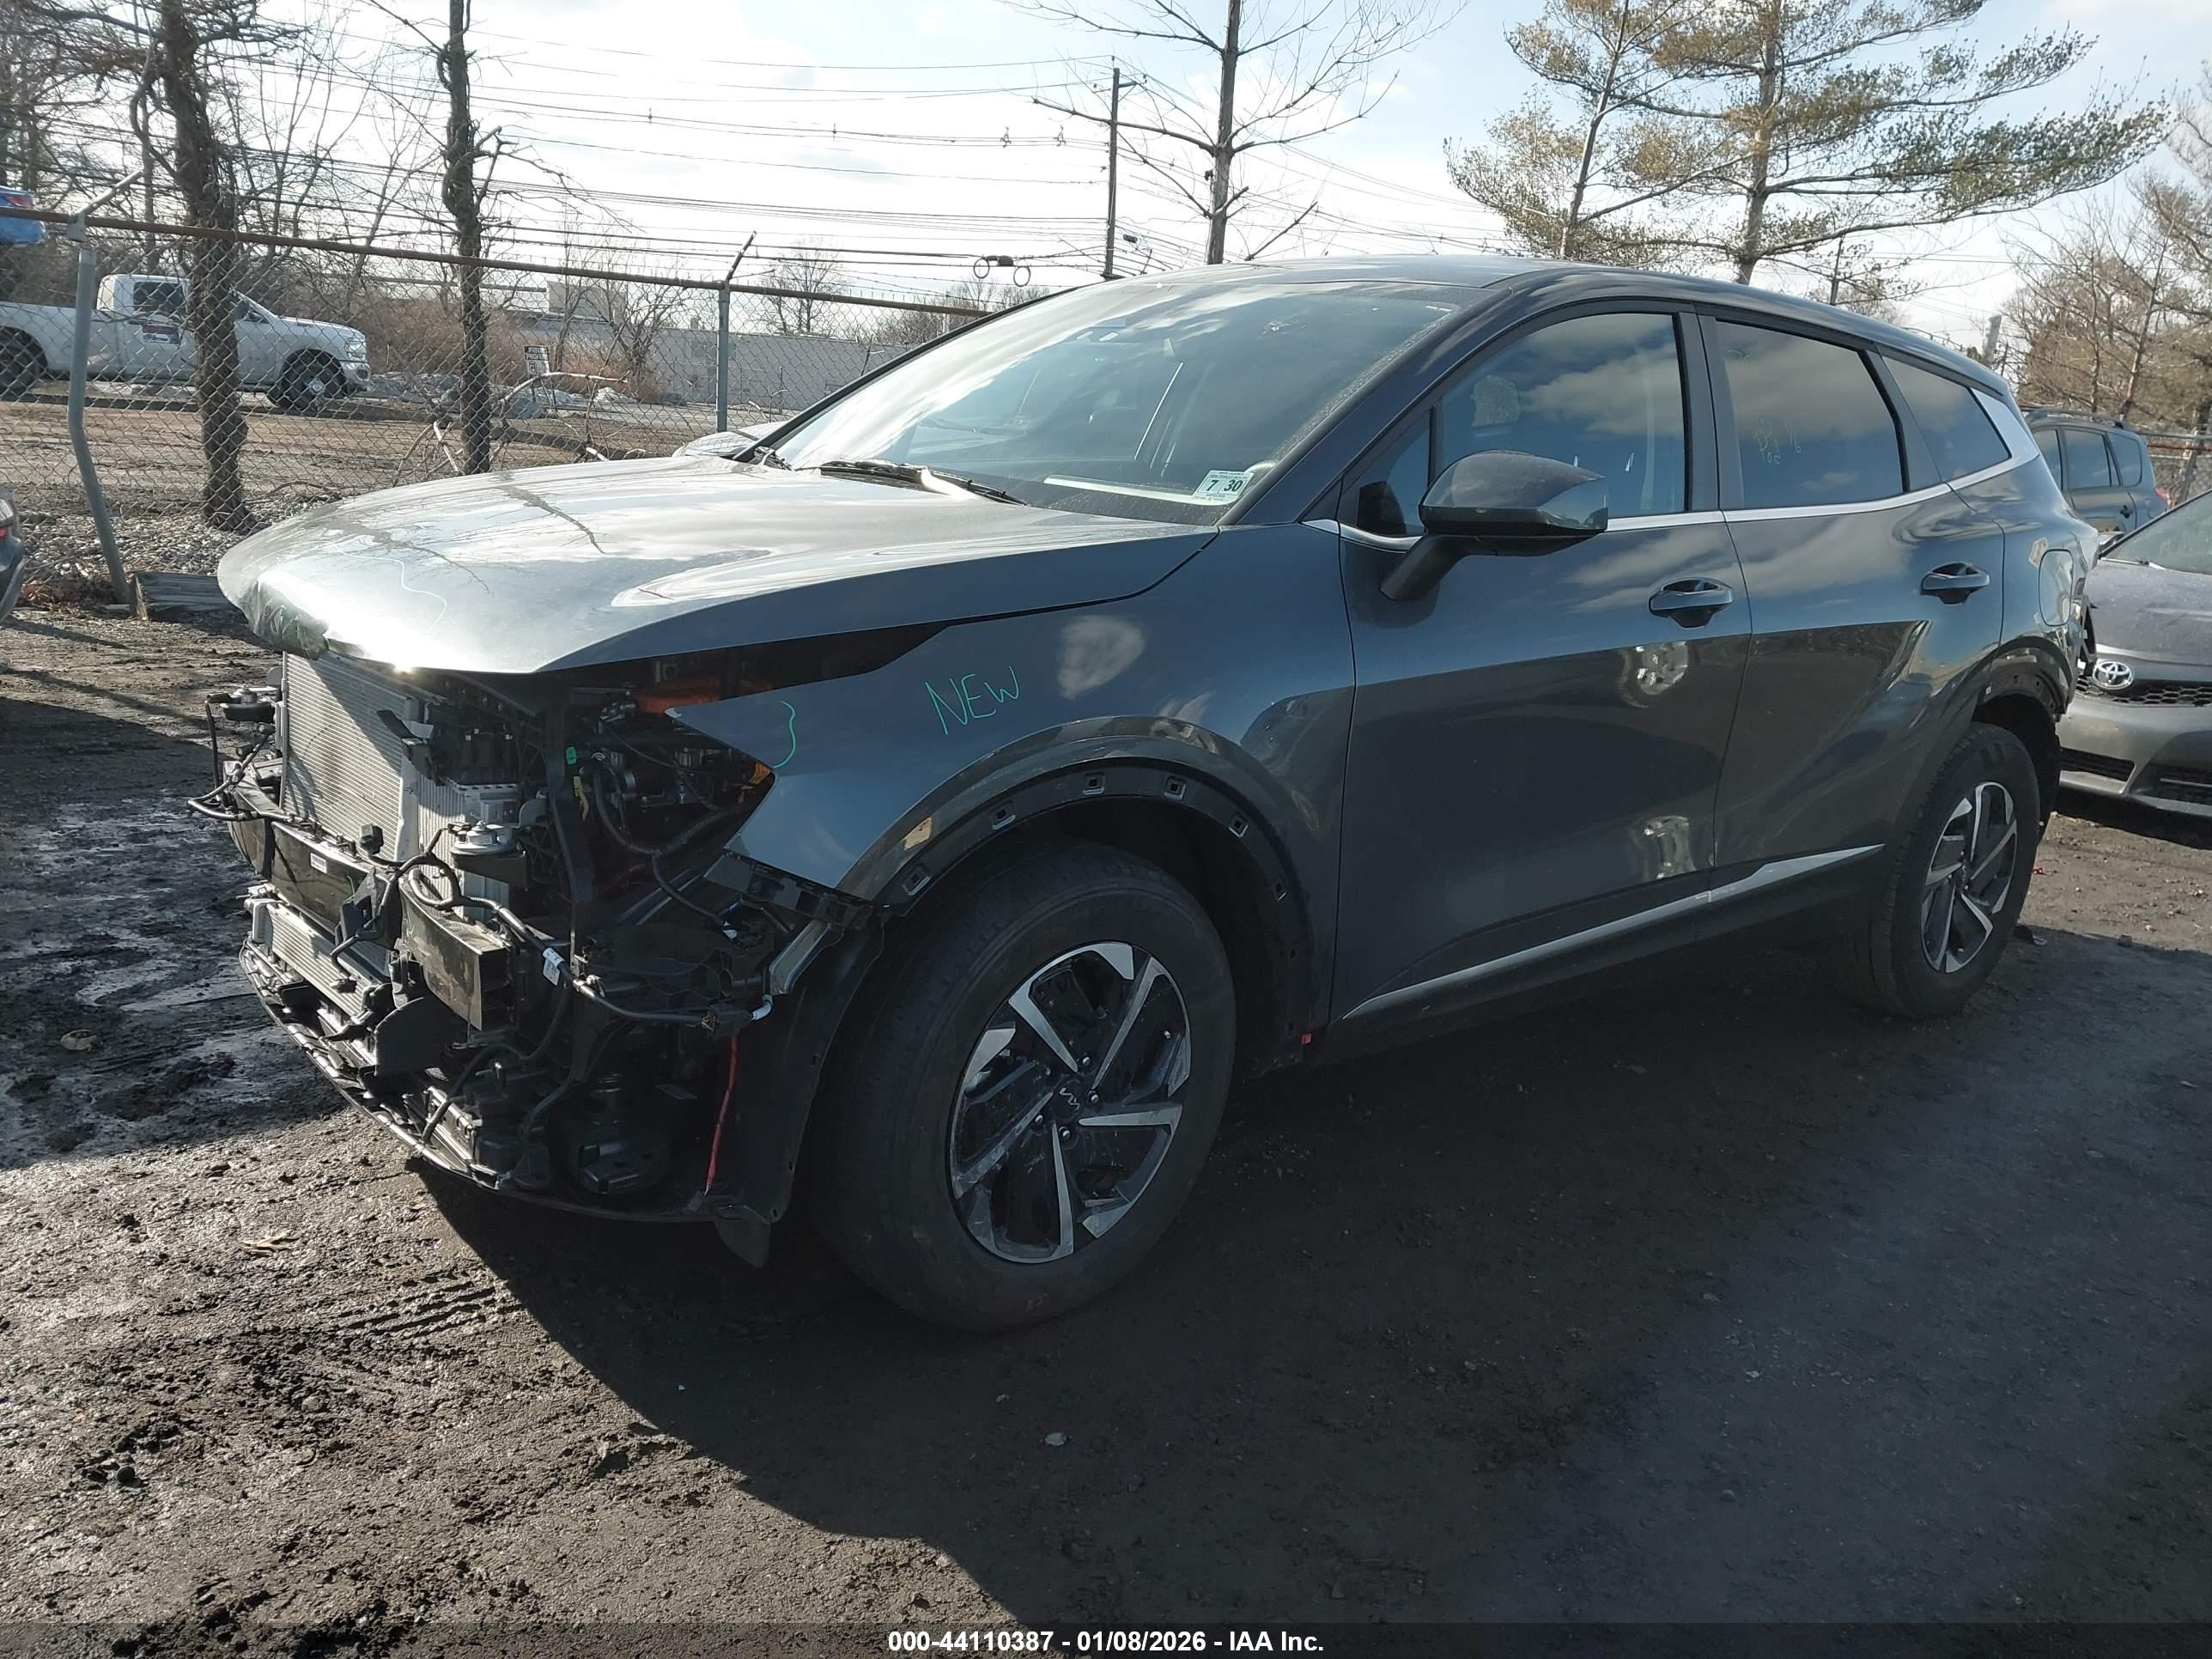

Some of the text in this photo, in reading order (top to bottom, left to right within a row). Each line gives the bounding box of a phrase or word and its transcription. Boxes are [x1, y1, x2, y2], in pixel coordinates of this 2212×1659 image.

[1206, 479, 1243, 492] 7 30
[924, 665, 1020, 735] NEW
